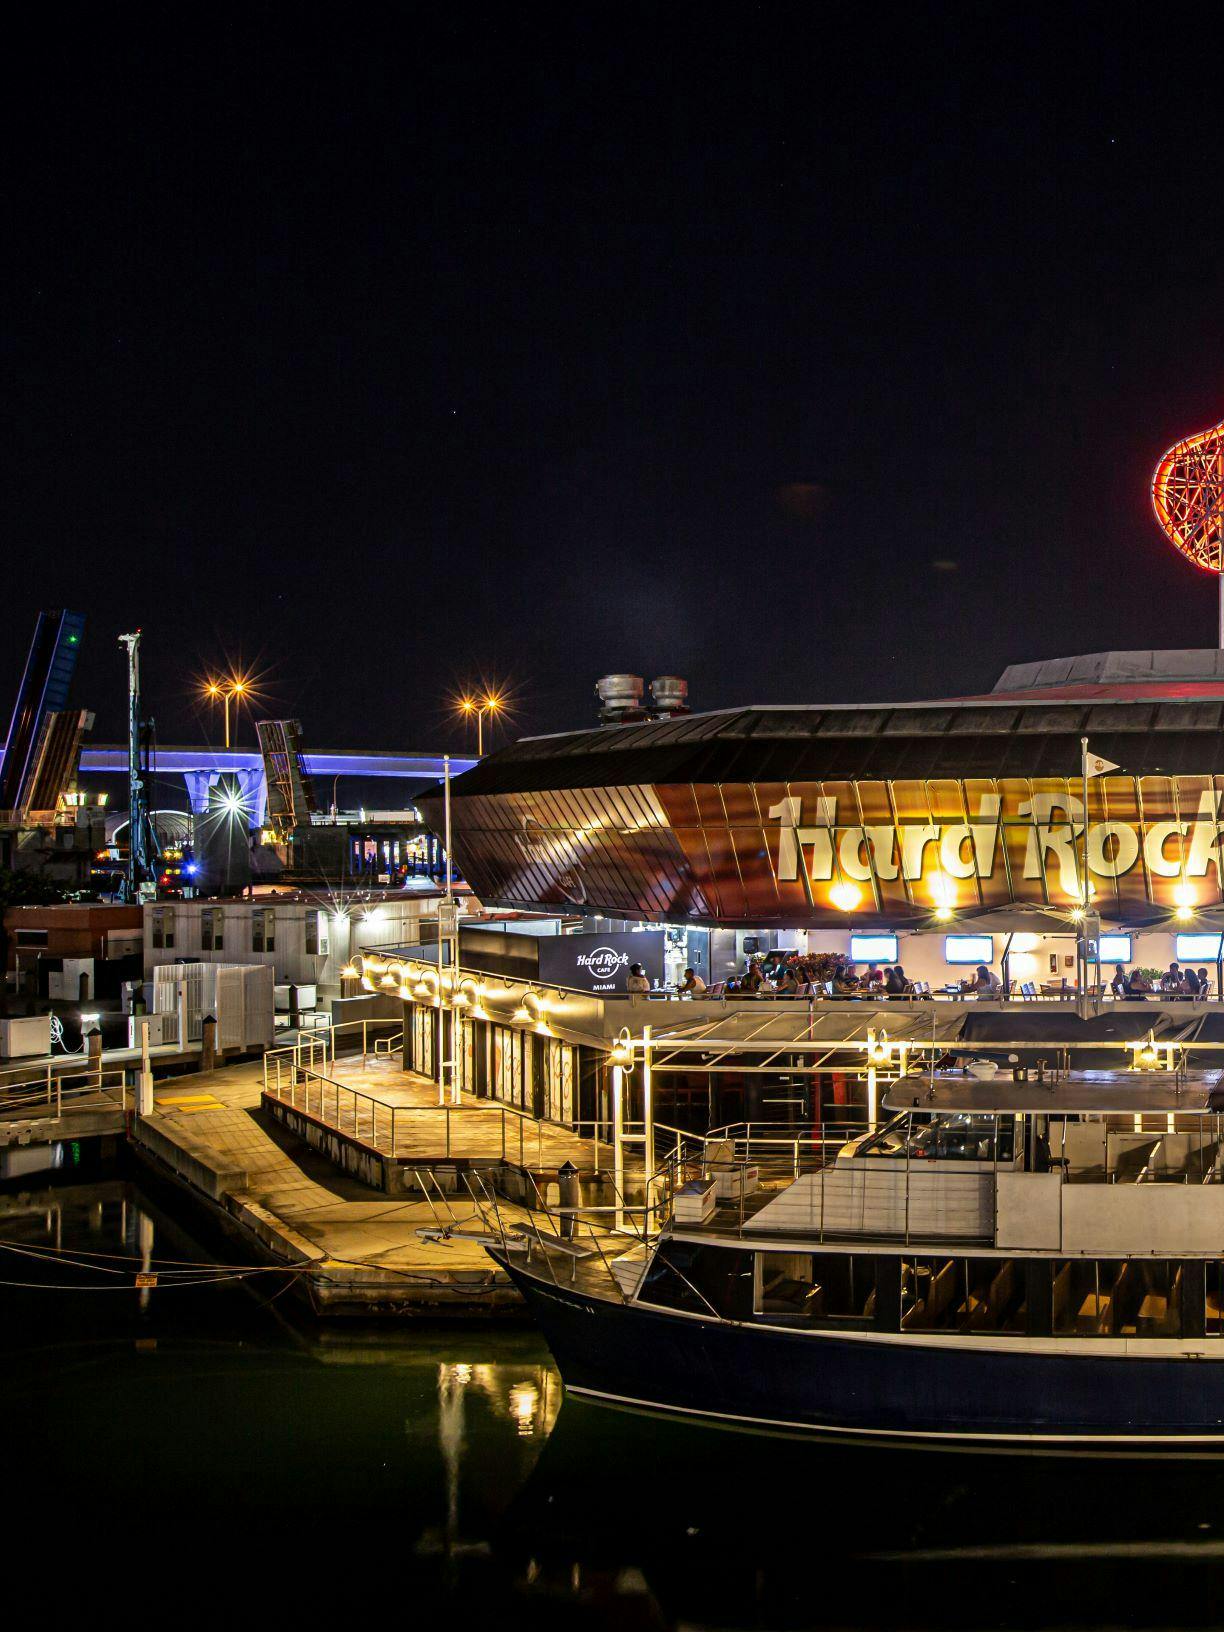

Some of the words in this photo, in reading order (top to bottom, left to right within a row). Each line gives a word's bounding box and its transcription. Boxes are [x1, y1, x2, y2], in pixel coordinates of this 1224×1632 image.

[768, 792, 1001, 881] Hard
[576, 953, 604, 966] Hard
[604, 952, 629, 966] Rock
[592, 983, 616, 991] MIAMI
